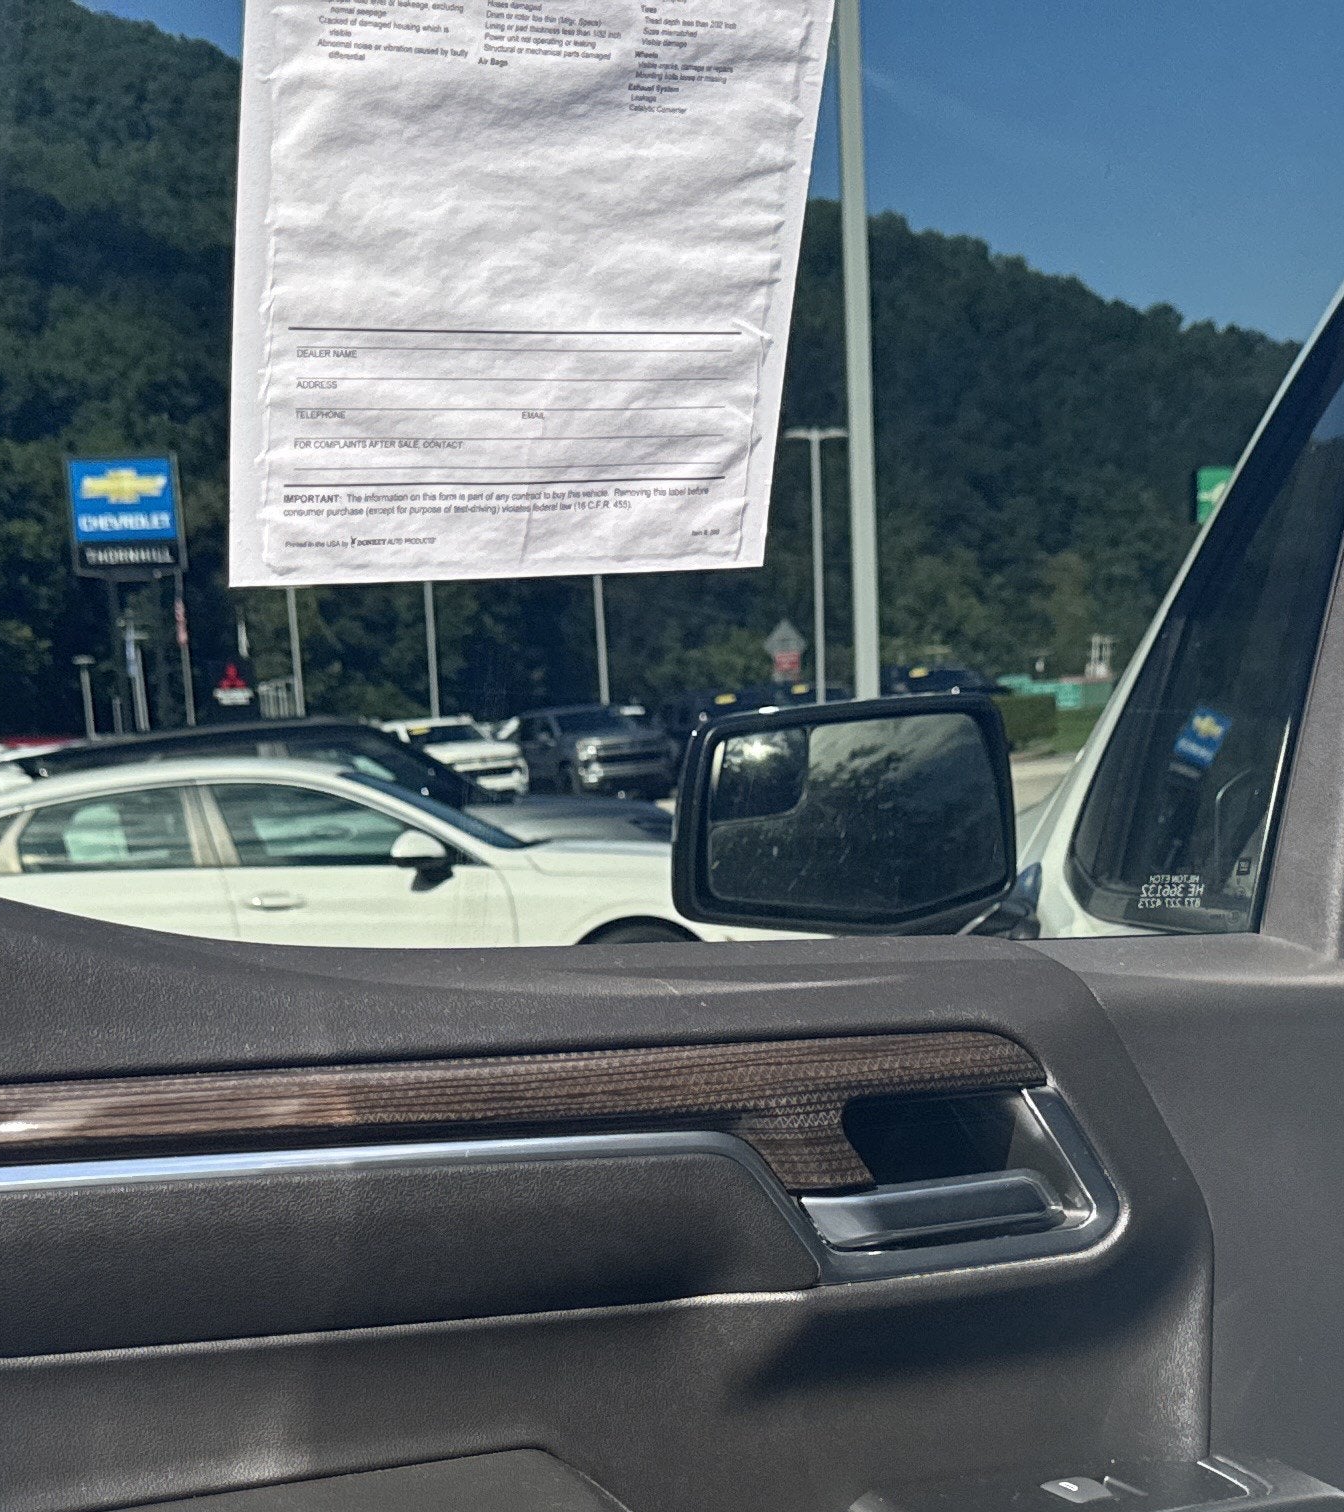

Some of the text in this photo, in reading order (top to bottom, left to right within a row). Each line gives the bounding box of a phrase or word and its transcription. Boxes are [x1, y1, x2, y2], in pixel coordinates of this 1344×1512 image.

[432, 3, 464, 14] excluding
[319, 15, 348, 25] Cracked
[359, 19, 391, 30] damaged
[393, 21, 420, 33] housing
[422, 24, 442, 33] which
[317, 39, 352, 49] Abnormal
[383, 44, 413, 53] vibration
[414, 46, 439, 55] caused
[440, 48, 448, 58] by
[296, 349, 357, 359] DEALER NAME
[296, 380, 338, 390] ADDRESS
[295, 410, 346, 419] TELEPHONE
[521, 411, 544, 420] EMAIL
[294, 440, 312, 449] FOR
[313, 440, 367, 449] COMPLAINTS
[368, 440, 396, 449] AFTER
[422, 440, 464, 449] CONTACT
[283, 494, 343, 503] IMPORTANT:
[346, 493, 362, 503] The
[364, 492, 408, 502] information
[422, 492, 436, 501] this
[438, 492, 457, 501] form
[459, 492, 465, 501] is
[467, 492, 484, 502] part
[485, 492, 494, 500] of
[495, 493, 510, 503] any
[511, 491, 542, 501] contract
[544, 491, 551, 499] to
[552, 491, 566, 501] buy
[567, 490, 581, 499] this
[614, 488, 652, 498] Removing
[653, 488, 667, 497] this
[668, 487, 686, 496] label
[687, 487, 709, 496] before
[283, 509, 324, 517] consumer
[326, 507, 364, 518] purchase
[365, 506, 395, 517] (except
[396, 504, 407, 514] for
[409, 506, 442, 515] purpose
[443, 504, 453, 513] of
[454, 503, 500, 515] test-driving)
[501, 504, 531, 513] violates
[532, 502, 557, 512] federal
[559, 501, 572, 511] law
[573, 501, 586, 512] (16
